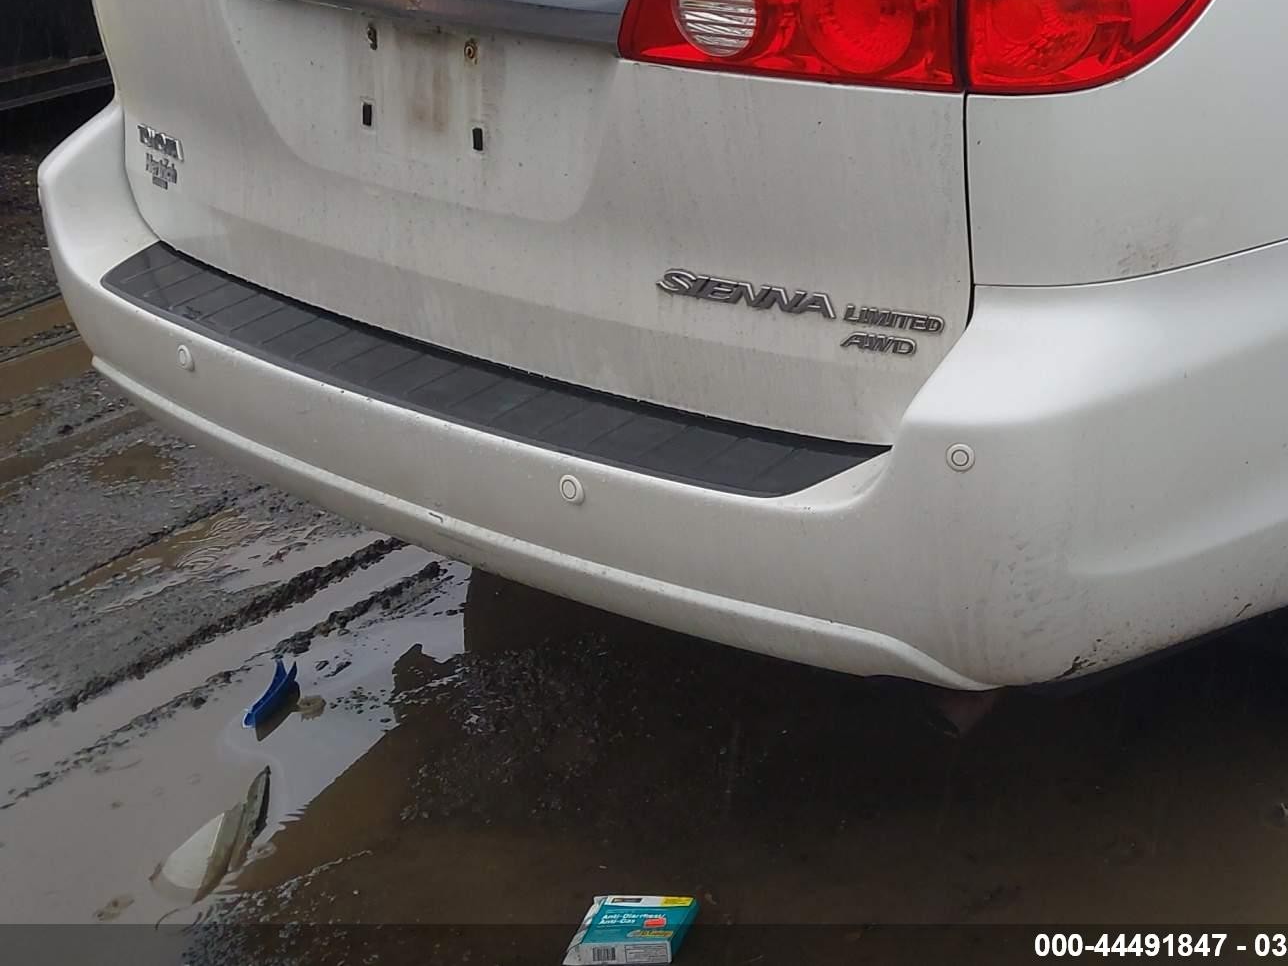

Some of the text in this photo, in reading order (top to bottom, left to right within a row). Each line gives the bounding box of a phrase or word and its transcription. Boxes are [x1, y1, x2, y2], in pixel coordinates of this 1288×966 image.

[656, 268, 945, 333] SIENNA LIMITED
[840, 332, 917, 356] AWD
